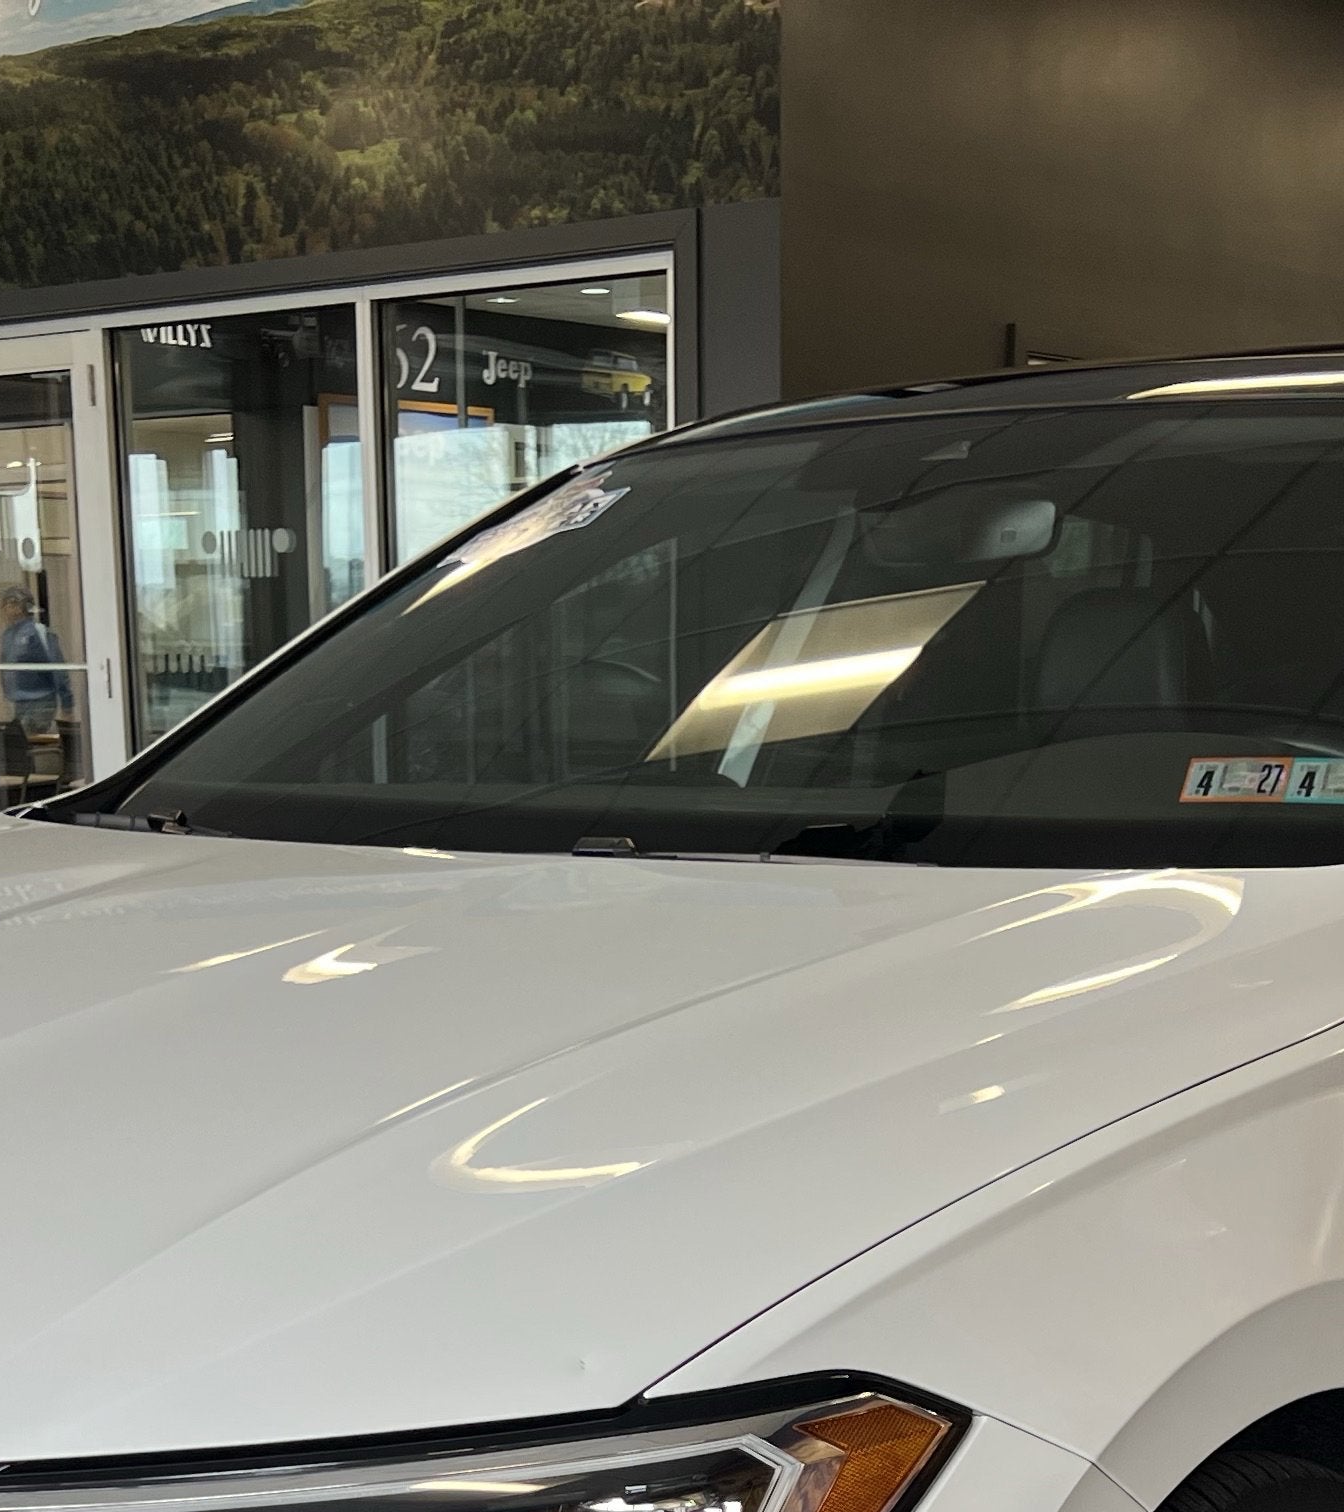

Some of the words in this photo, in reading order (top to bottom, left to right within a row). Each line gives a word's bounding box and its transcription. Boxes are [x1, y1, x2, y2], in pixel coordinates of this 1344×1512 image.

[482, 350, 533, 388] Jeep
[1197, 770, 1215, 796] 4
[1257, 764, 1285, 796] 27
[1299, 771, 1317, 797] 4
